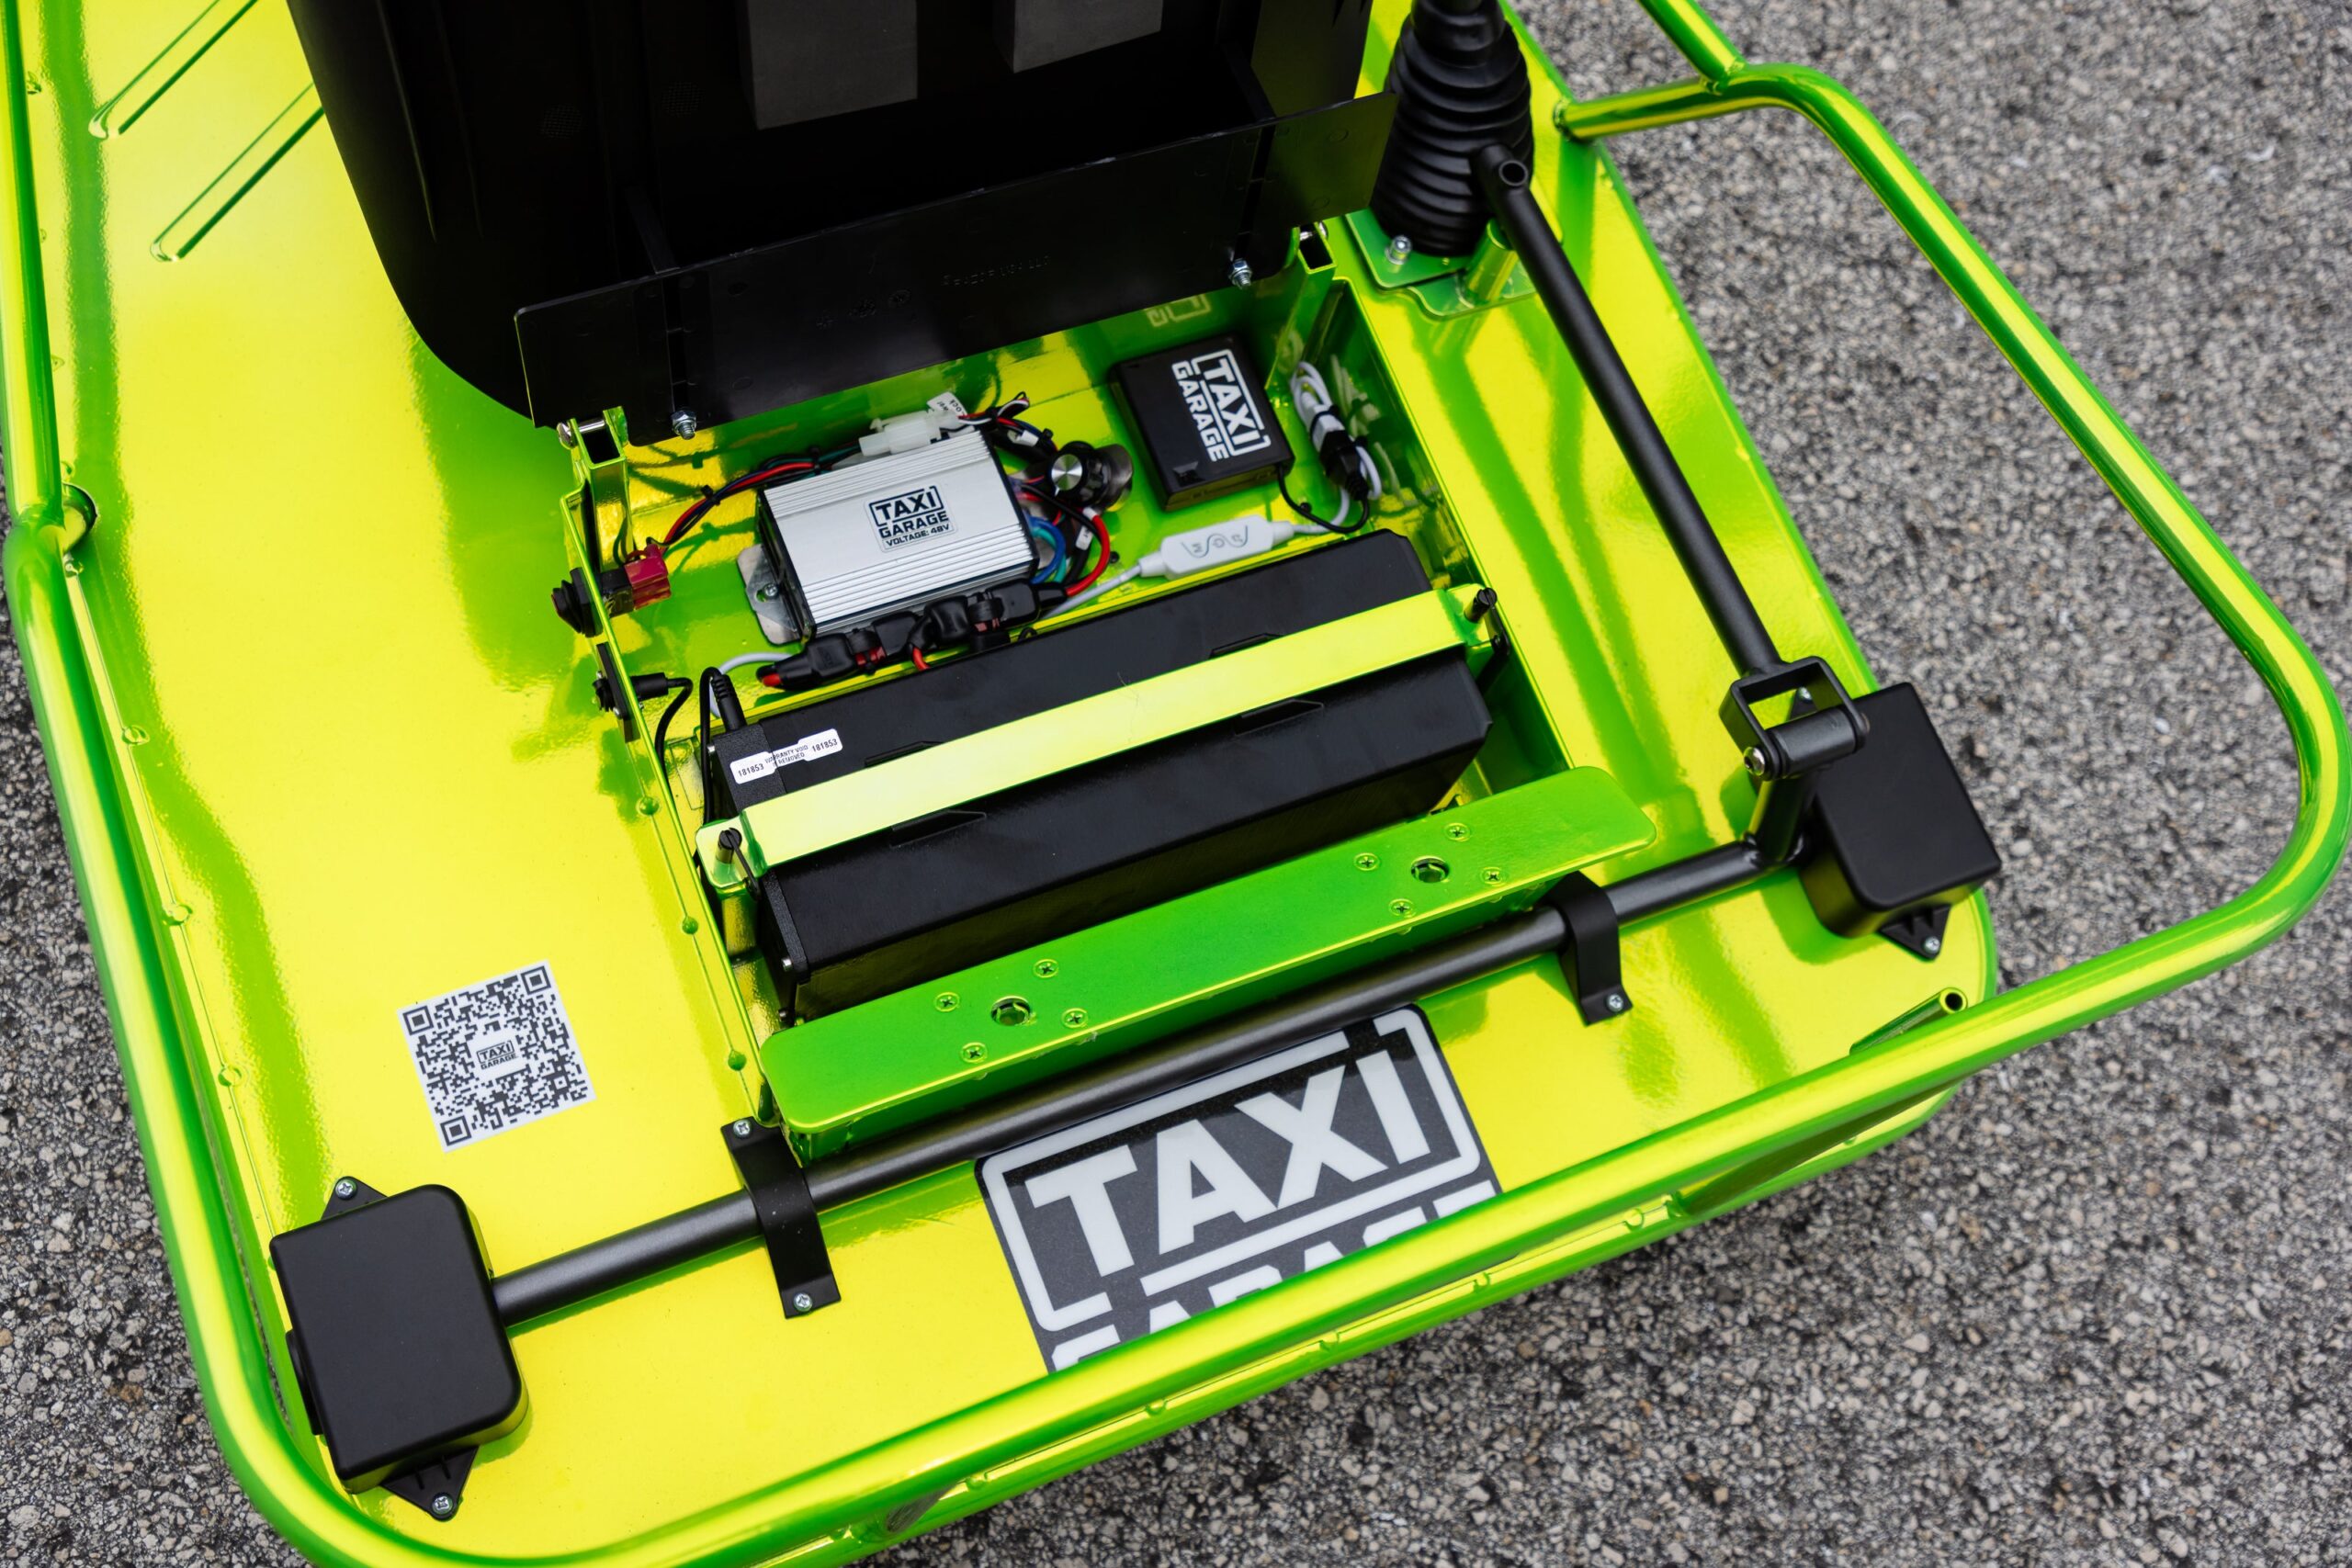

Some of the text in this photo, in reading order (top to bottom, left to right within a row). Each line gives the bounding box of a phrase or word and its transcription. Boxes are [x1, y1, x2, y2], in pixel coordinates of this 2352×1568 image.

[1171, 360, 1229, 461] GARAGE
[1204, 358, 1261, 446] TAXI
[875, 491, 936, 521] TAXI
[878, 511, 949, 538] GARAGE
[886, 524, 950, 547] VOLTAGE: 48V
[795, 745, 808, 753] VOID
[811, 739, 838, 752] 181853
[738, 763, 764, 777] 181853
[480, 1043, 511, 1060] TAXI
[481, 1054, 517, 1069] GARAGE
[1024, 1050, 1431, 1277] TAXI
